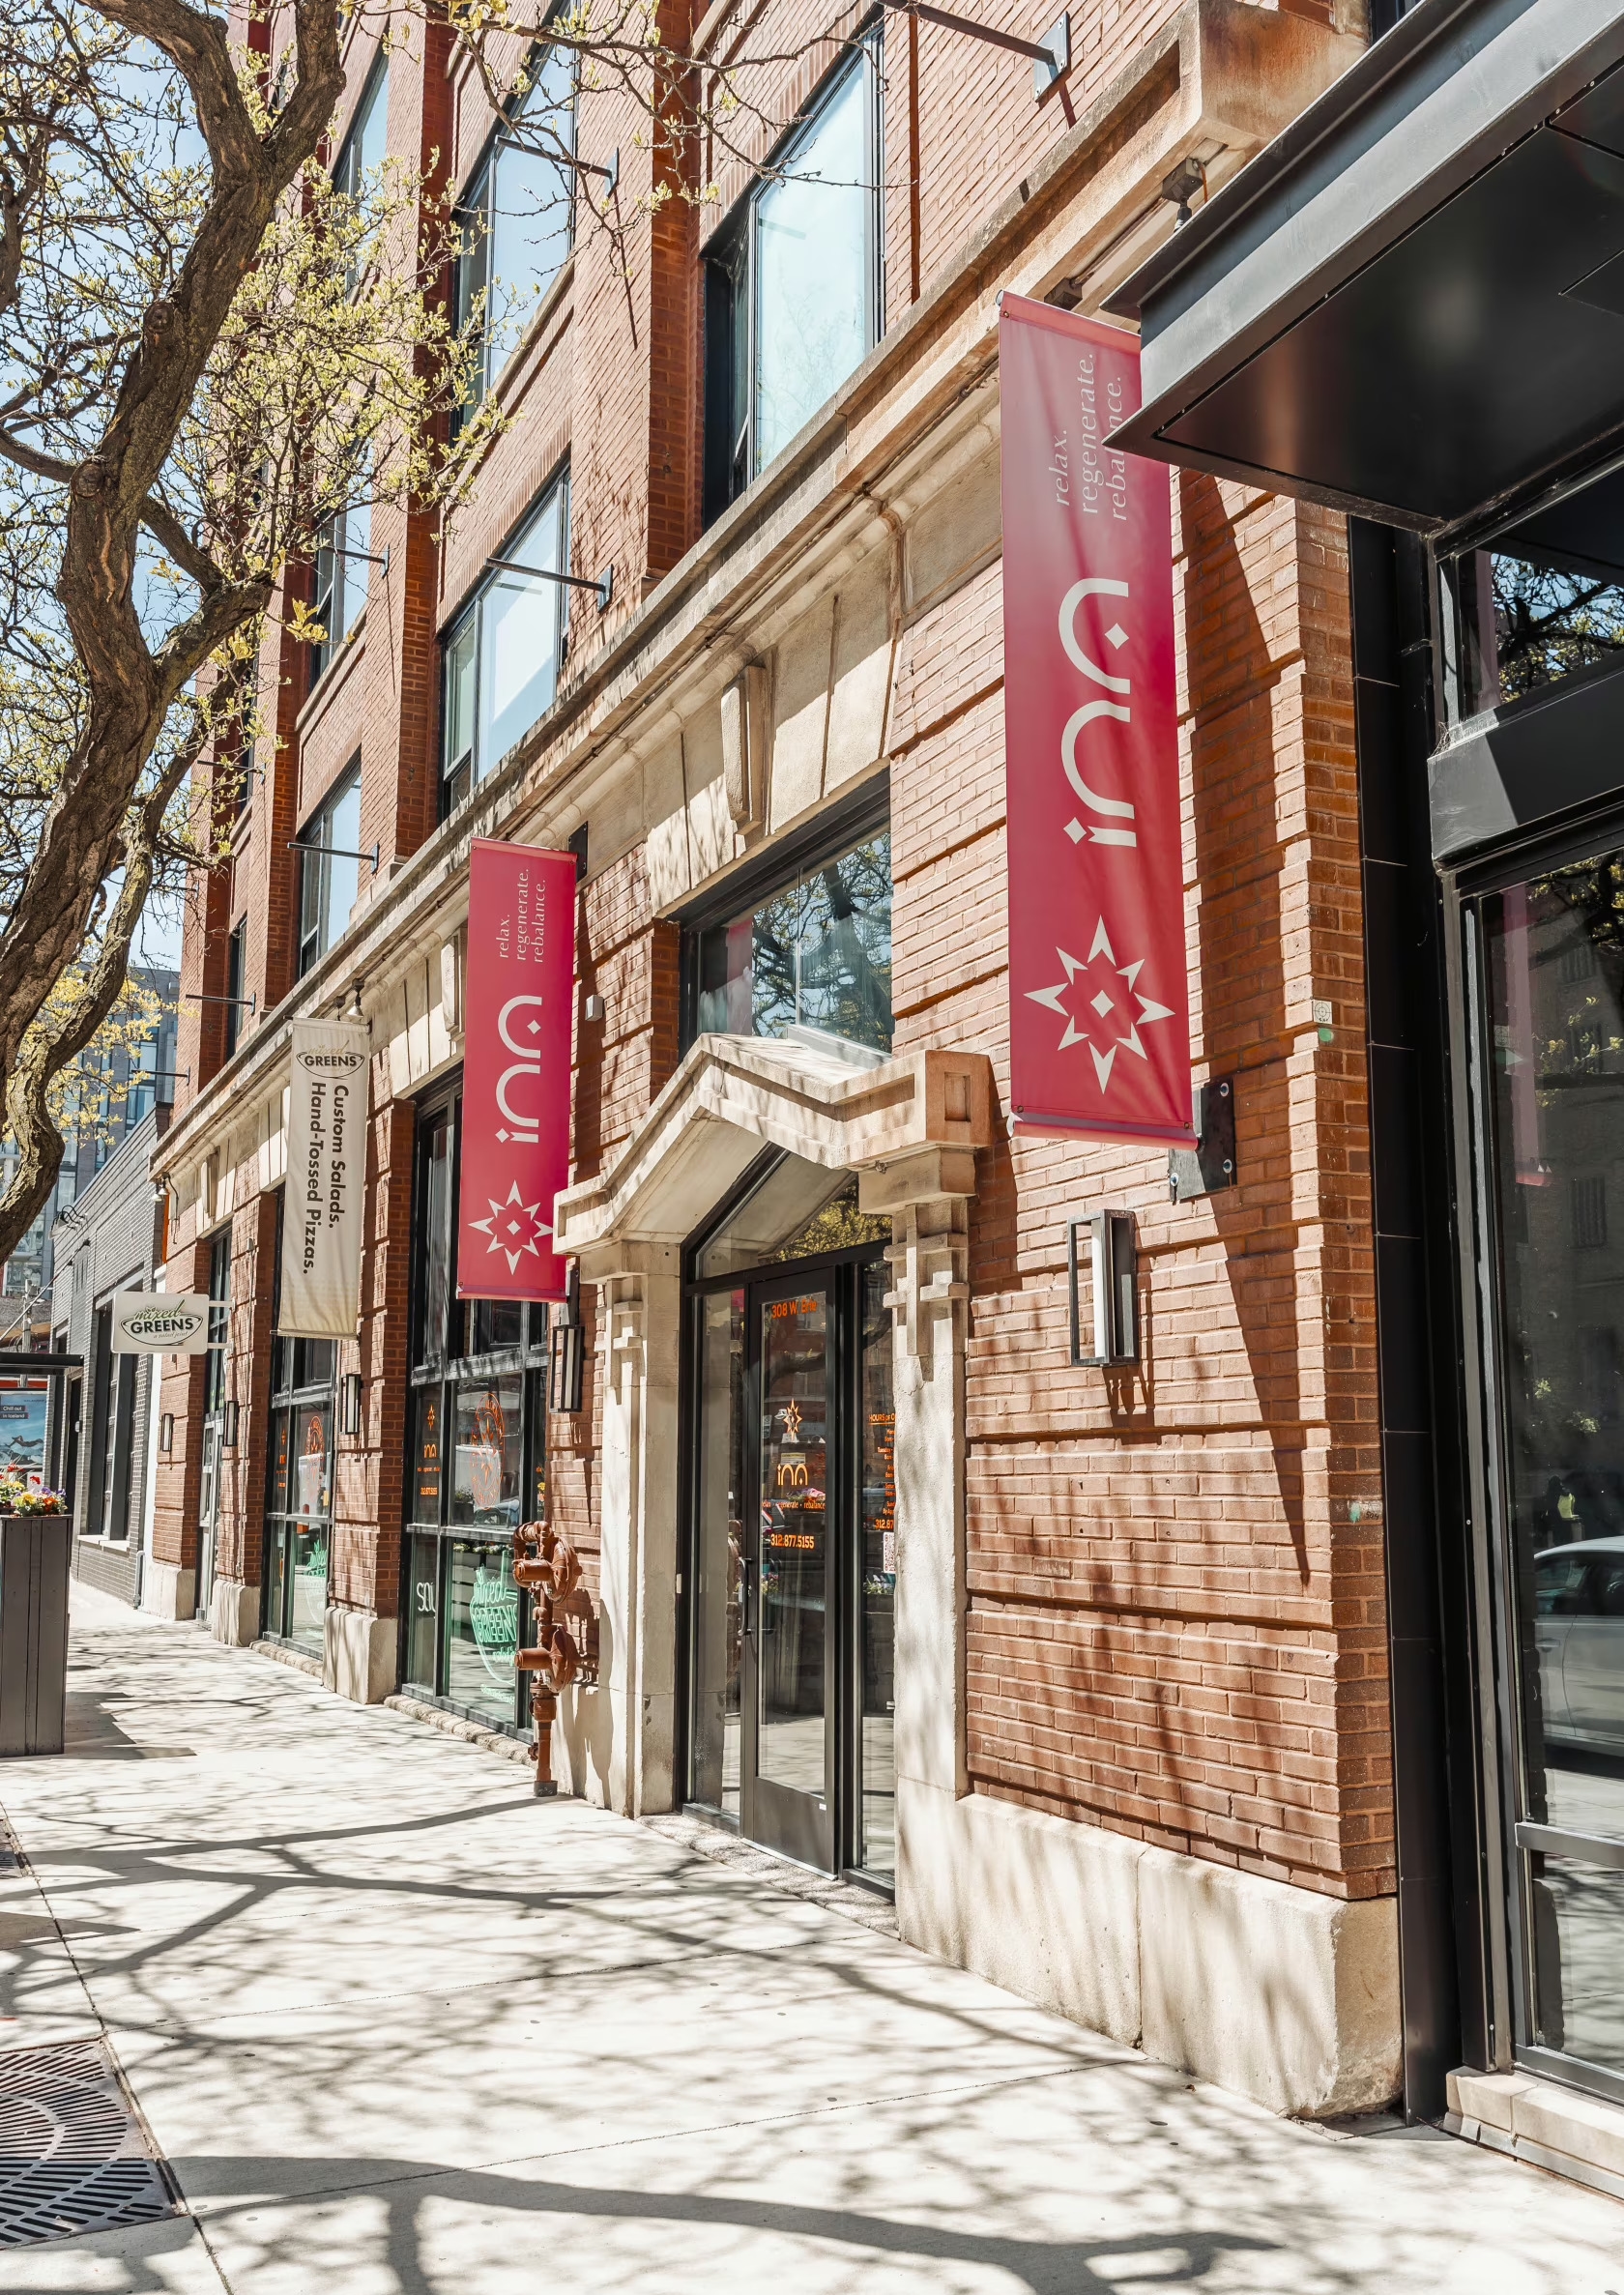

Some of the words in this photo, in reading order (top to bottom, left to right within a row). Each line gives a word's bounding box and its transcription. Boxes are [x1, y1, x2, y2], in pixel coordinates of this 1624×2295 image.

[1077, 354, 1105, 513] regenerate.
[1105, 377, 1127, 521] rebalnce.
[1049, 429, 1070, 506] relax.
[496, 915, 510, 958] relax.
[516, 869, 531, 961] regenerate.
[531, 880, 546, 963] rebalance.
[304, 1055, 357, 1067] GREENS
[306, 1082, 327, 1203] Hand-Tossed
[333, 1085, 349, 1153] Custom
[329, 1160, 346, 1229] Salads.
[303, 1208, 322, 1274] Pizzas.
[130, 1318, 193, 1334] GREENS
[135, 1299, 185, 1322] mixed
[771, 1302, 788, 1319] 308
[770, 1533, 815, 1549] 312.877.5155
[875, 1519, 894, 1529] 312.87.
